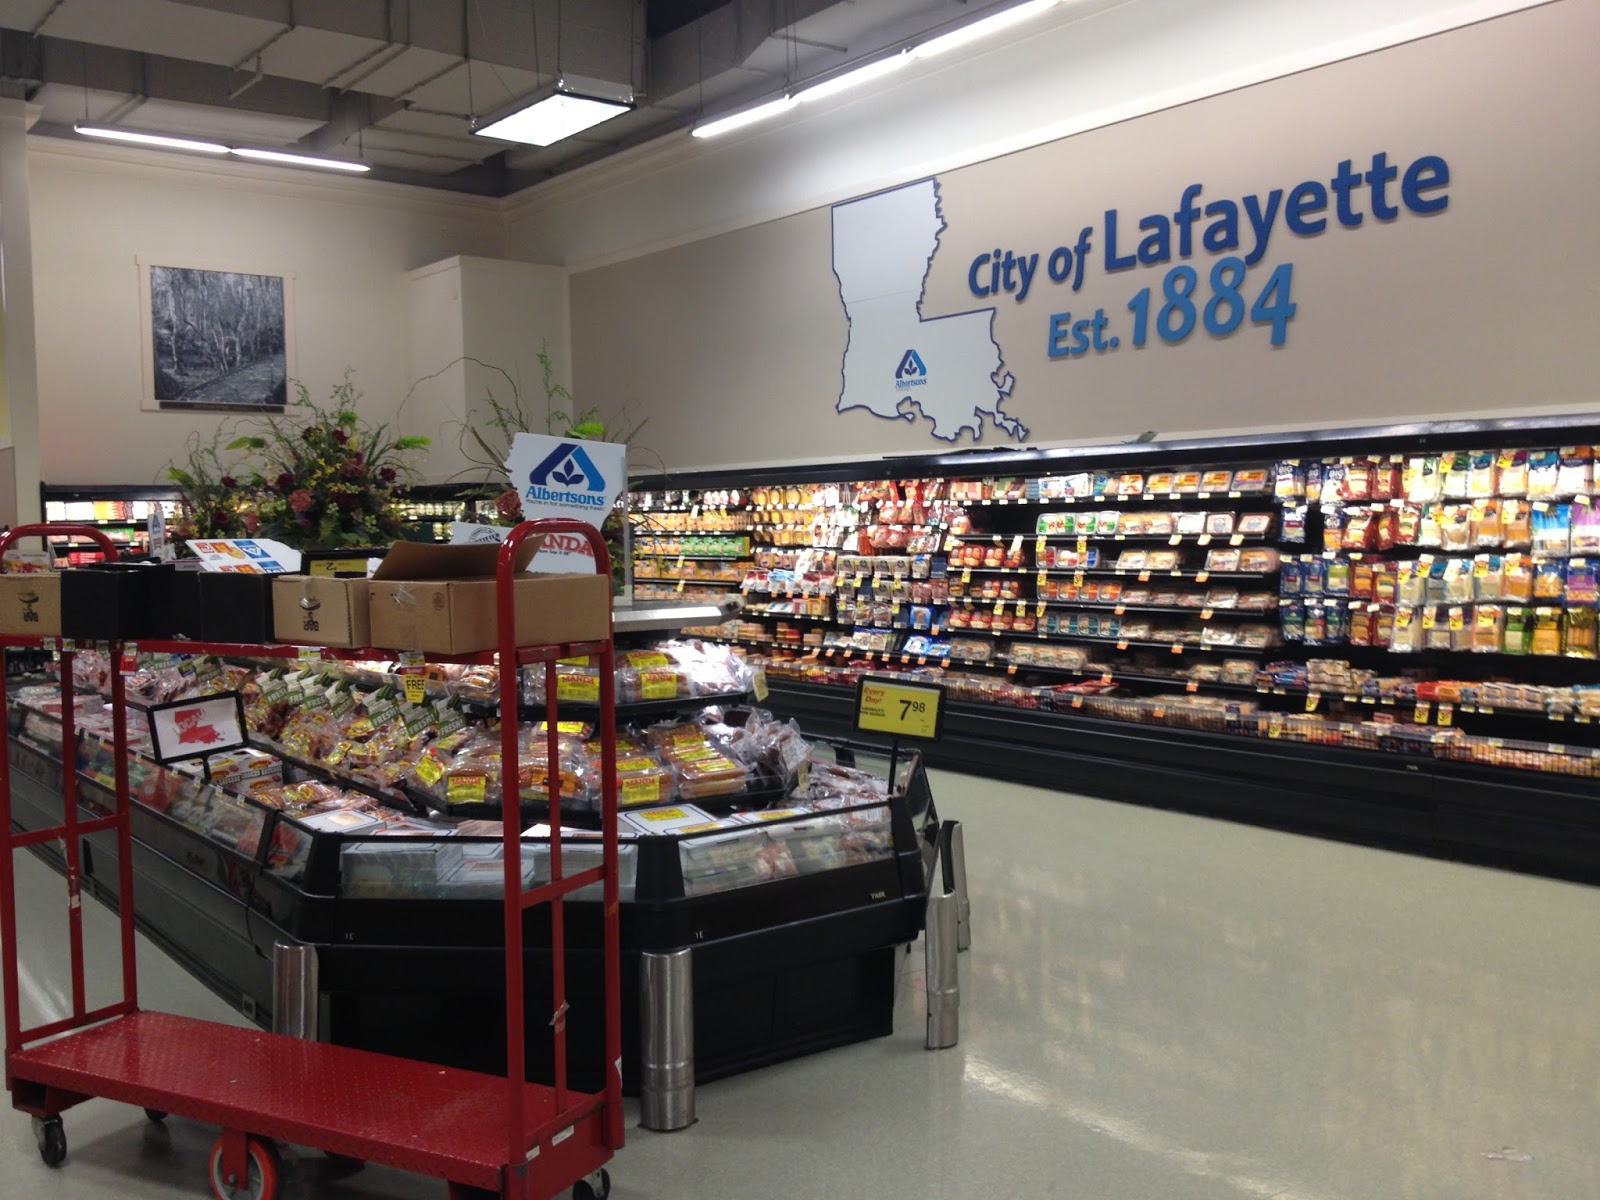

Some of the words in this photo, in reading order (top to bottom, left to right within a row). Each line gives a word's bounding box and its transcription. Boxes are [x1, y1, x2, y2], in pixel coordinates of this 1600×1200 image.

[968, 248, 1039, 300] City
[1047, 227, 1093, 292] of
[1103, 152, 1449, 271] Lafayette
[1047, 308, 1119, 358] Est.
[1127, 256, 1297, 346] 1884
[525, 485, 604, 506] Albertsons
[558, 503, 589, 511] something
[540, 534, 594, 558] ANDA
[406, 680, 425, 690] FREE
[561, 674, 595, 685] MANDA
[864, 687, 885, 697] Every
[865, 695, 882, 705] Day!
